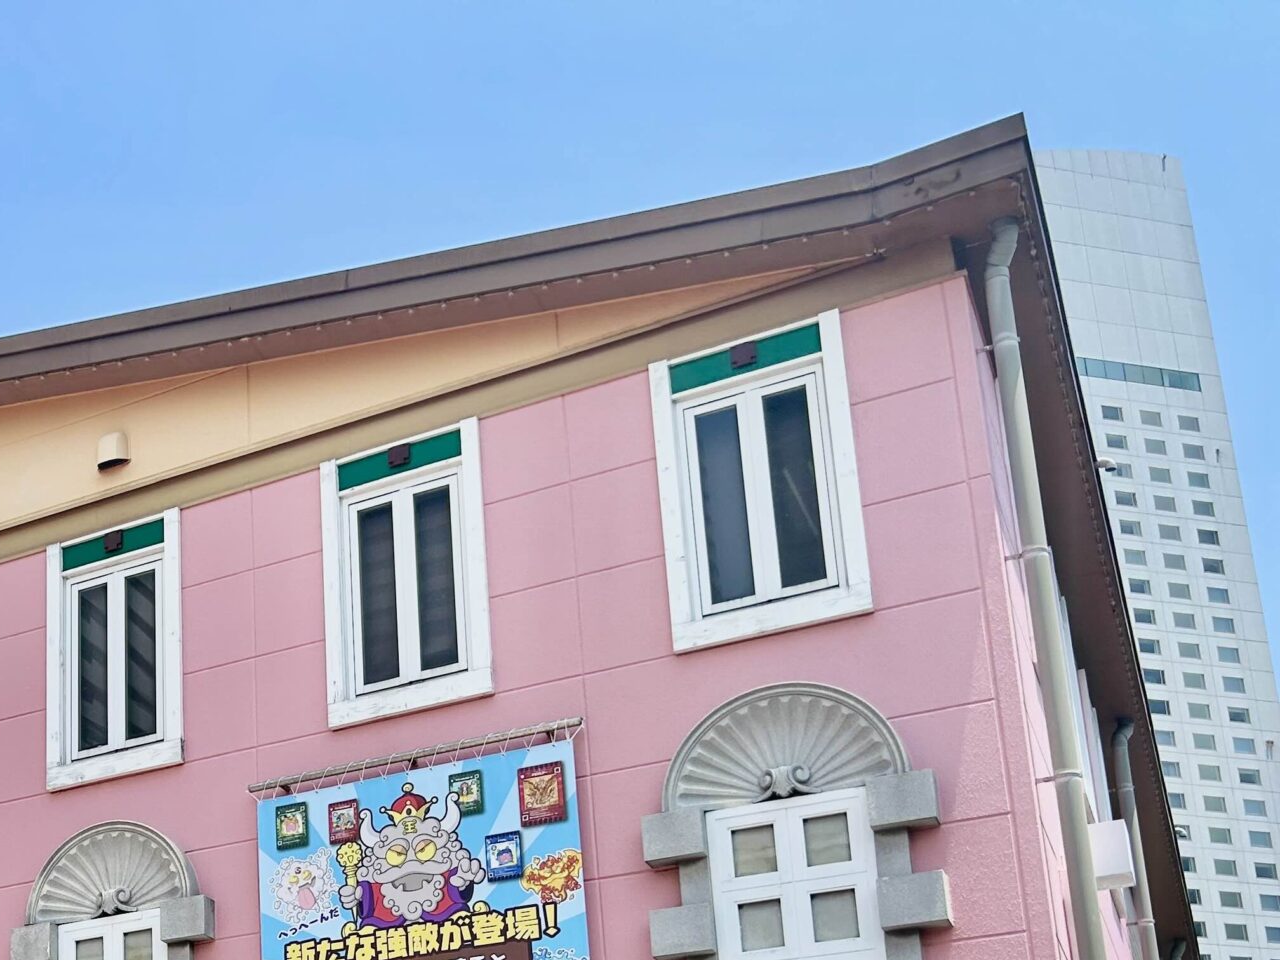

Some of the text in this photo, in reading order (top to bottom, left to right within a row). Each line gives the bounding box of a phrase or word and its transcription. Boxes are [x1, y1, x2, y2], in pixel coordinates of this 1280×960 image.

[278, 907, 340, 939] へっへーんだ
